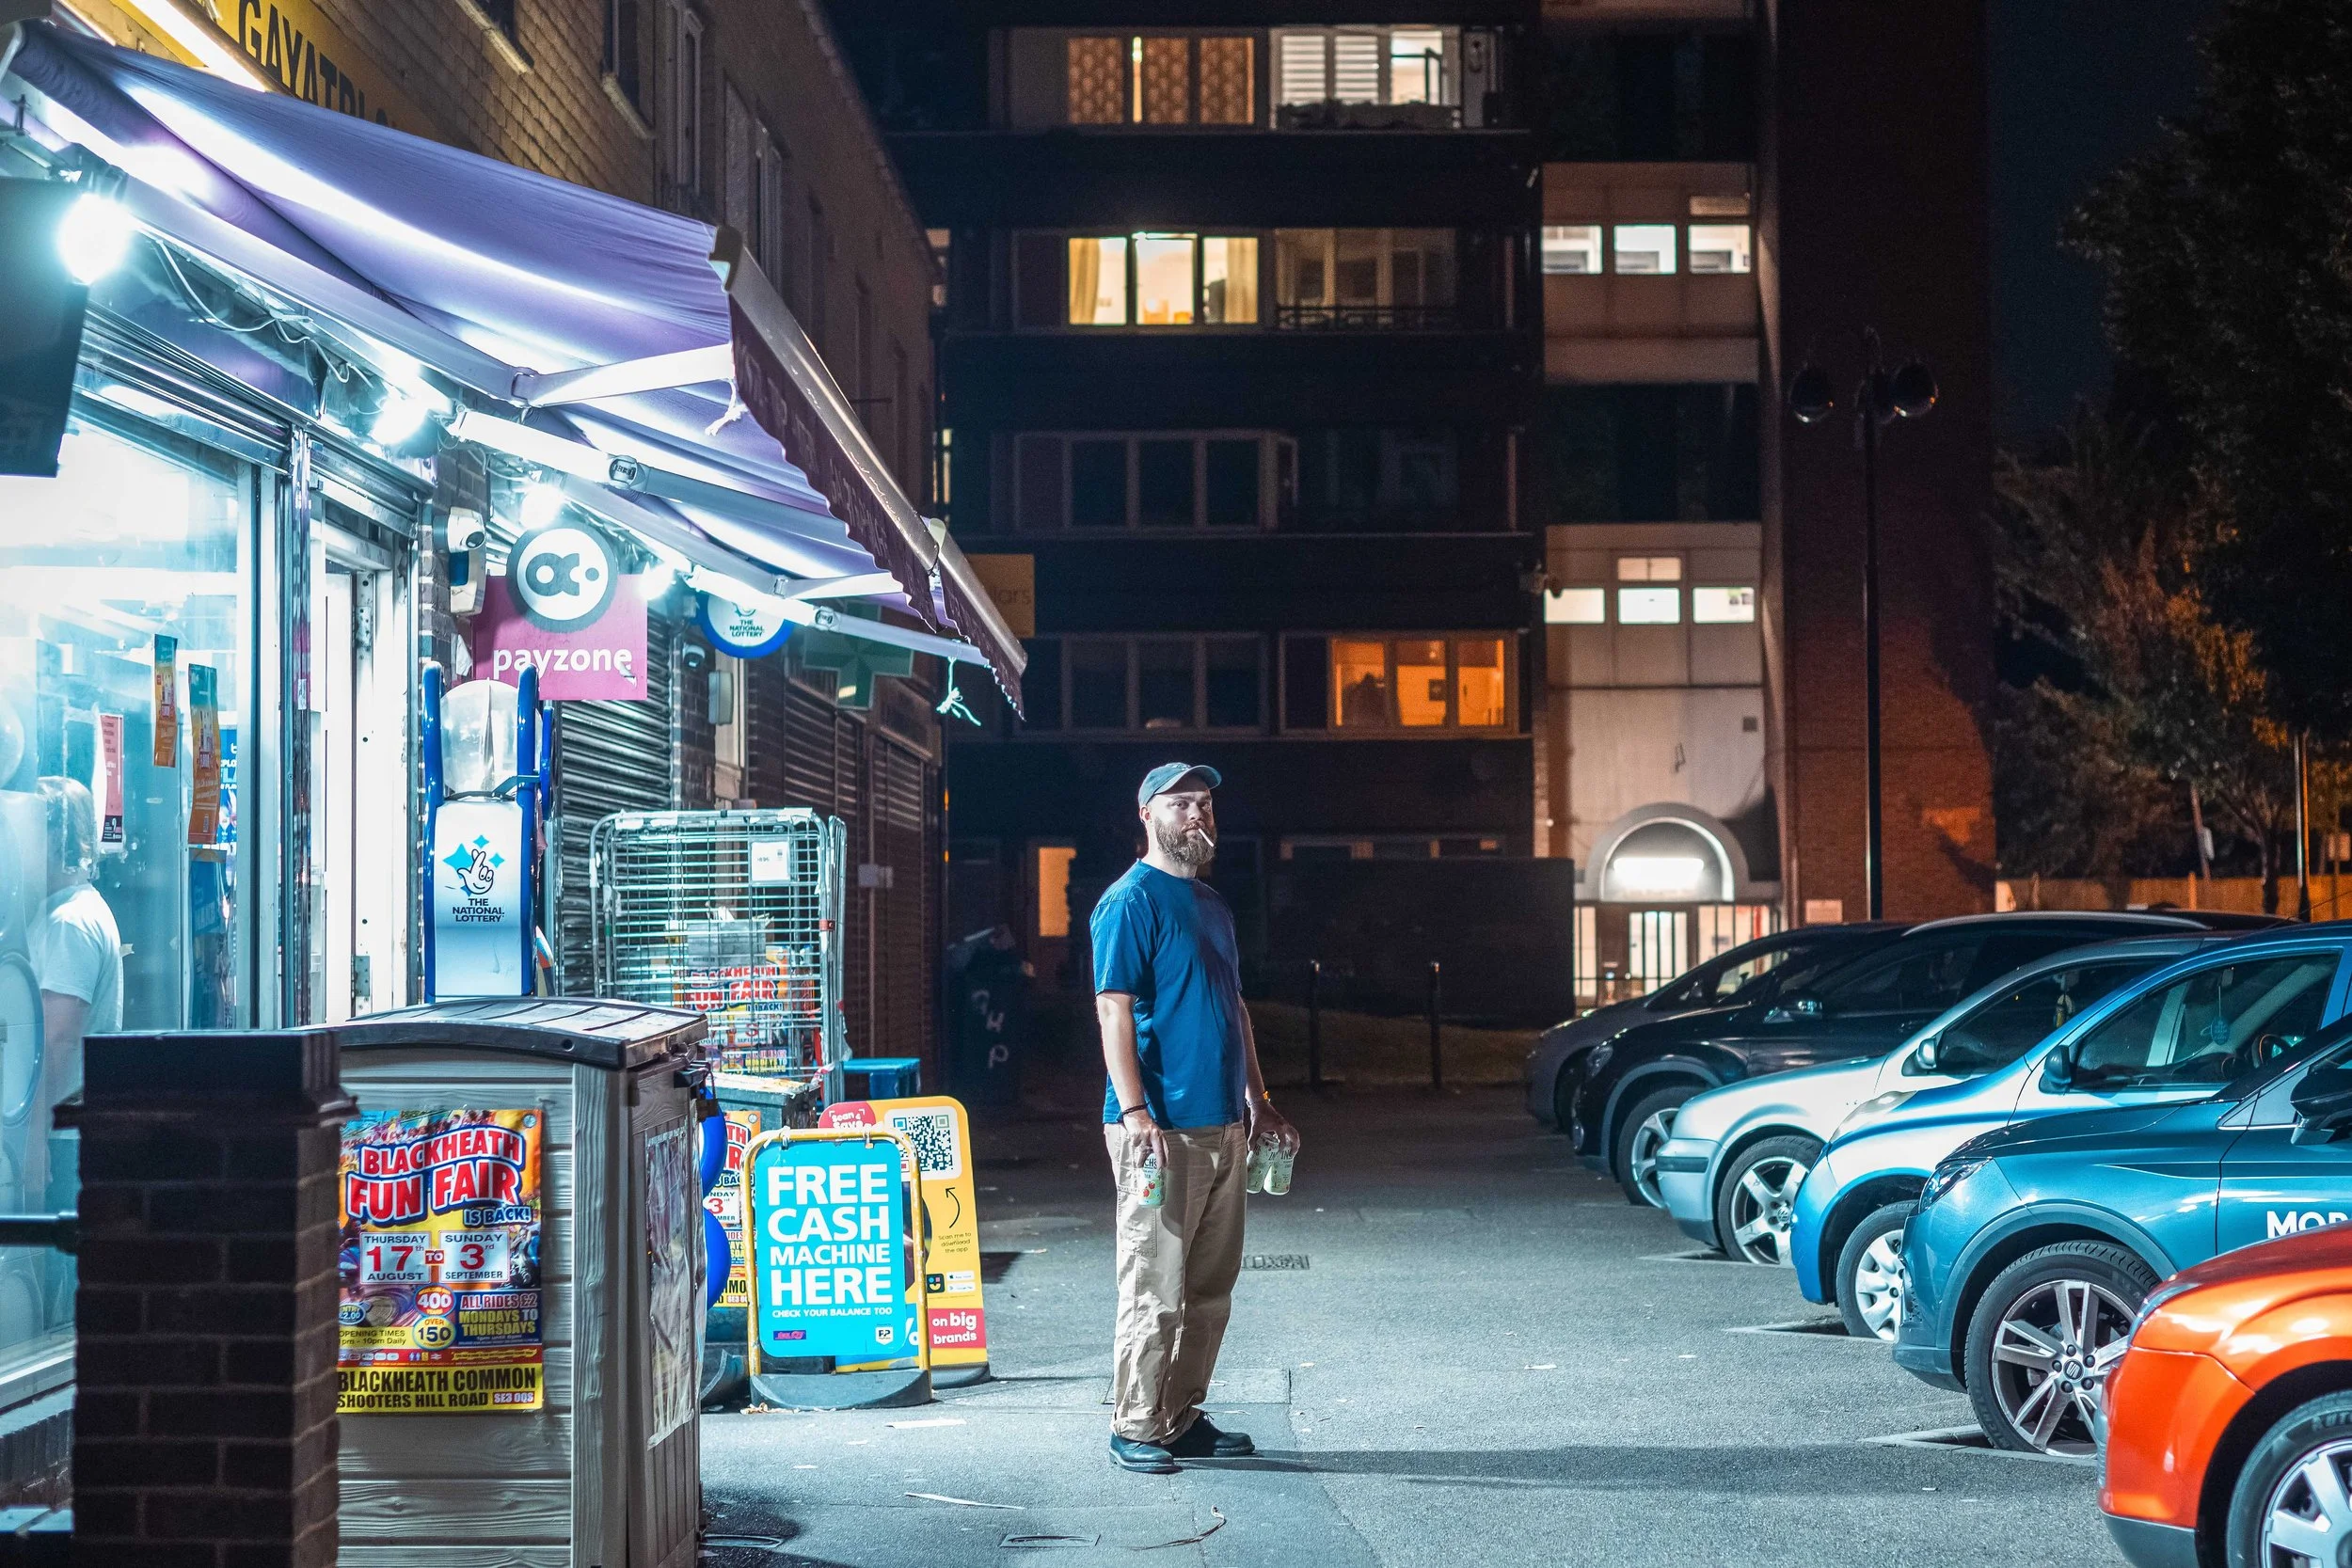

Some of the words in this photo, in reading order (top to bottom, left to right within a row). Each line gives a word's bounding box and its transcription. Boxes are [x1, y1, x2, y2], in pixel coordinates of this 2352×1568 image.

[493, 648, 633, 678] payzone
[729, 979, 776, 1002] FAIR
[361, 1129, 521, 1175] BLACKHEATH
[349, 1176, 421, 1220] FUN
[434, 1161, 517, 1208] FAIR
[768, 1164, 889, 1206] FREE
[465, 1210, 480, 1224] IS
[485, 1207, 532, 1223] BACK!
[768, 1206, 890, 1243] CASH
[364, 1235, 426, 1243] THURSDAY
[941, 1239, 971, 1247] download
[770, 1243, 890, 1266] MACHINE
[445, 1271, 502, 1279] SEPTEMBER
[771, 1266, 893, 1307] HERE
[418, 1292, 452, 1308] 400
[461, 1294, 482, 1309] ALL
[483, 1294, 519, 1308] RIDES
[458, 1310, 519, 1323] MONDAYS
[521, 1308, 538, 1321] TO
[830, 1307, 871, 1316] BALANCE
[932, 1317, 948, 1327] on
[949, 1311, 977, 1330] big
[418, 1326, 452, 1342] 150
[461, 1322, 536, 1336] THURSDAYS
[933, 1331, 977, 1345] brands
[339, 1370, 449, 1392] BLACKHEATH
[453, 1368, 535, 1391] COMMON
[338, 1394, 412, 1407] SHOOTERS
[415, 1394, 445, 1407] HILL
[449, 1392, 488, 1407] ROAD
